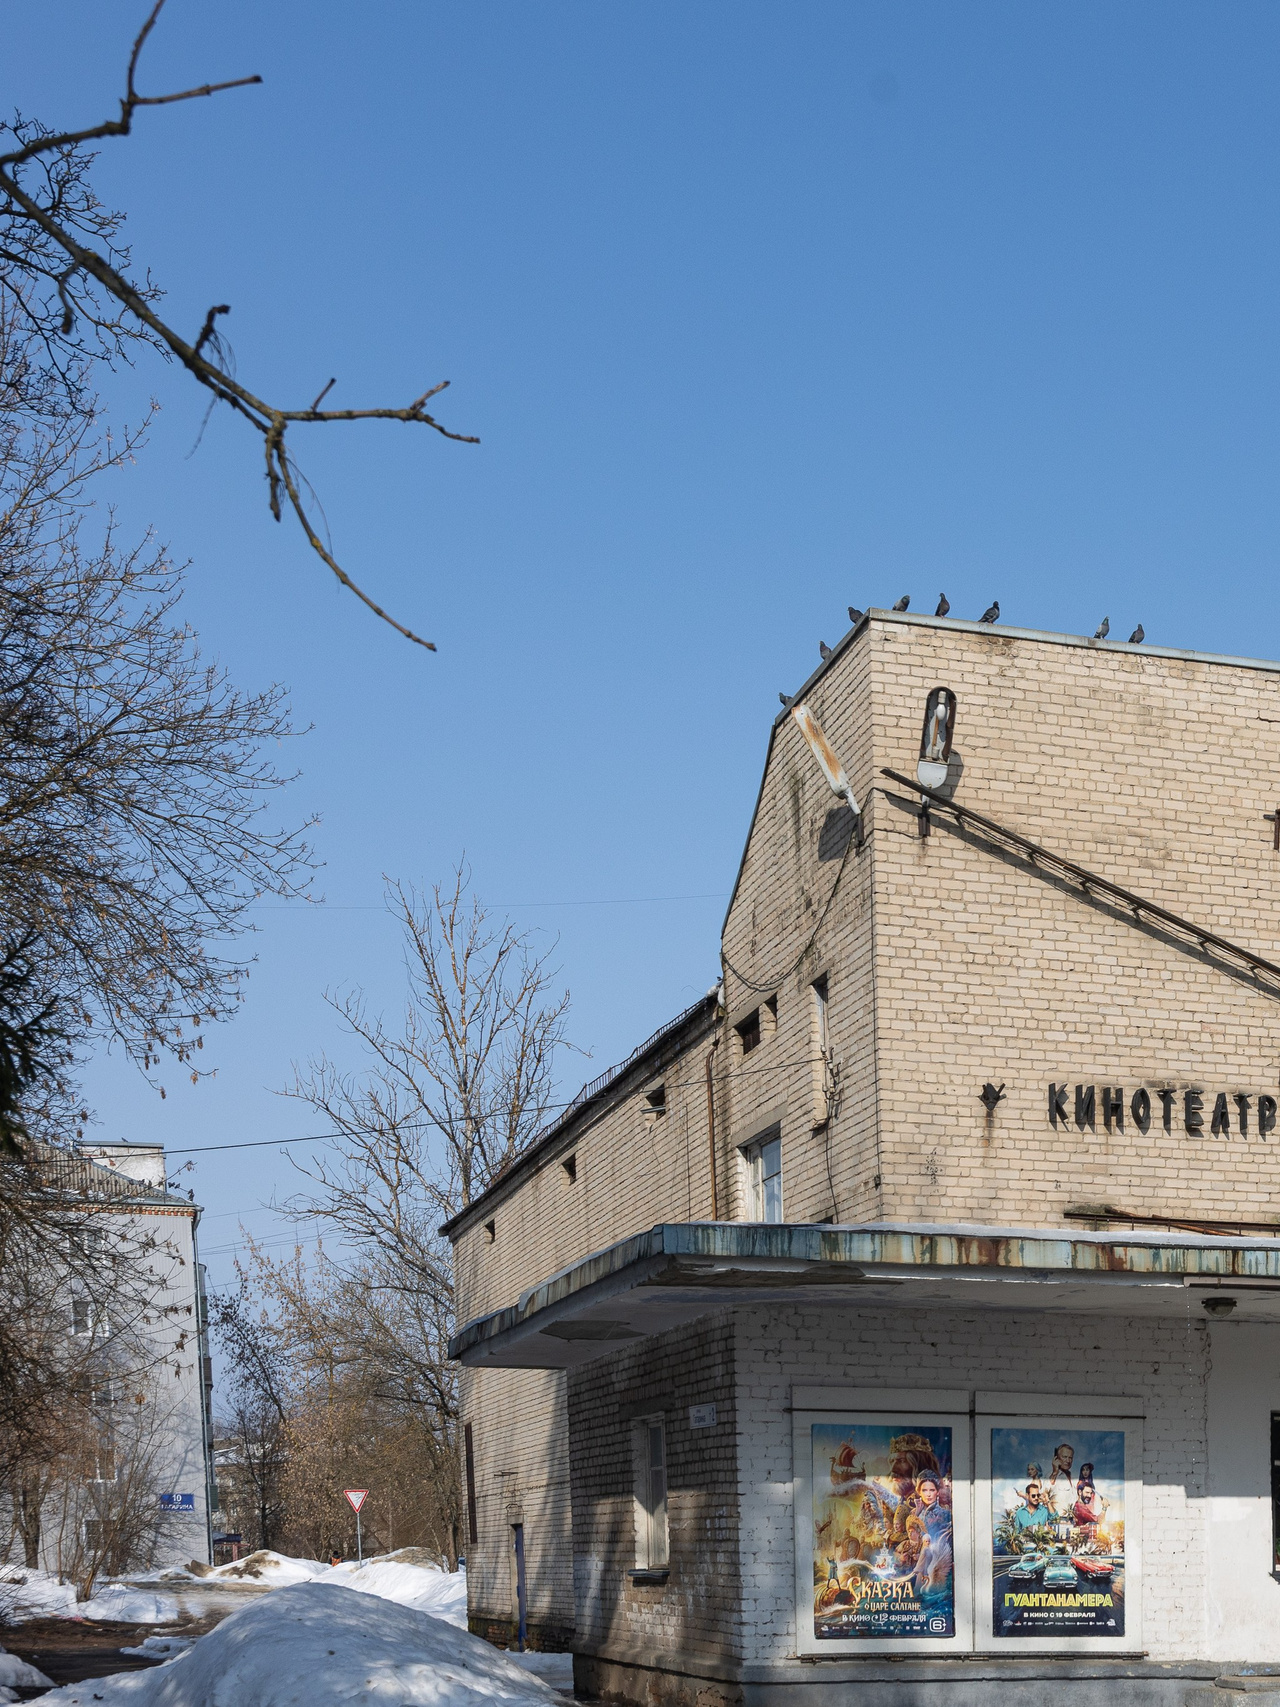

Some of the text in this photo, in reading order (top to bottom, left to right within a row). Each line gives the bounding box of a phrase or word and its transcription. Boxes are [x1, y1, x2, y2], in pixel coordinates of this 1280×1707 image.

[1048, 1082, 1278, 1134] КИНОТЕАТР
[172, 1494, 182, 1502] 10
[1004, 1593, 1114, 1607] ГУАНТАНАМЕРА
[870, 1602, 889, 1612] ЦАРЕ
[890, 1602, 921, 1611] САЛТАНЕ
[849, 1614, 870, 1622] КИНО
[889, 1614, 926, 1623] ФЕВРАЛЯ
[933, 1620, 947, 1630] 6+
